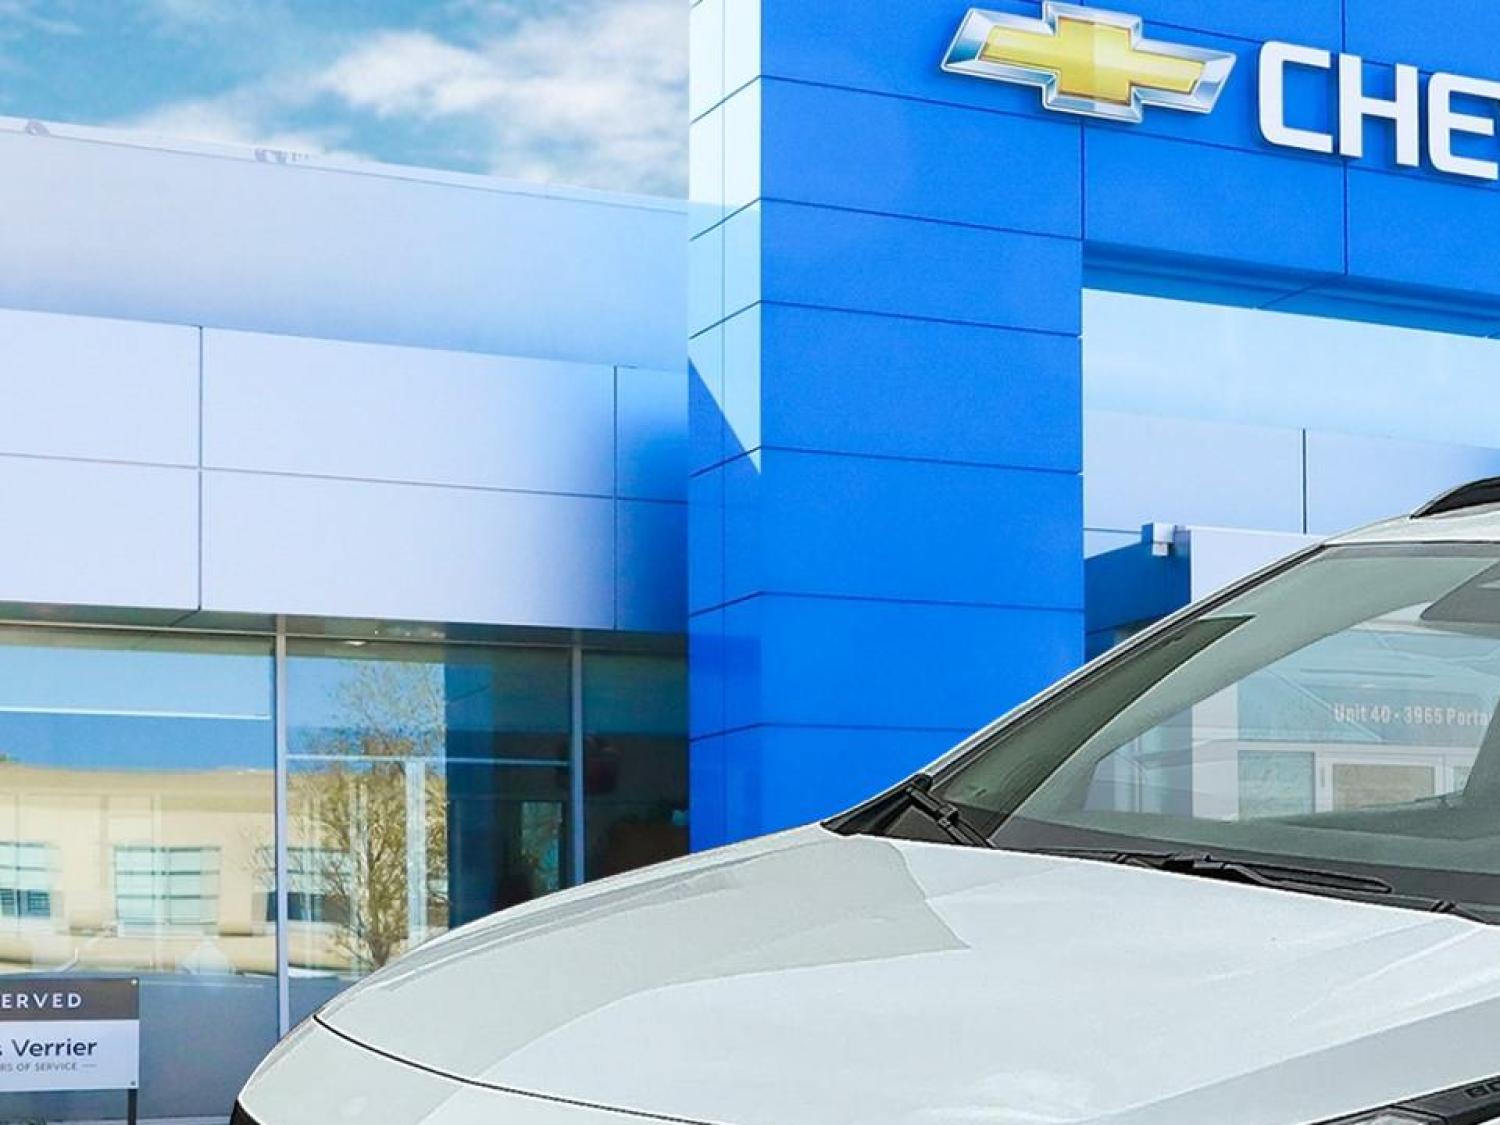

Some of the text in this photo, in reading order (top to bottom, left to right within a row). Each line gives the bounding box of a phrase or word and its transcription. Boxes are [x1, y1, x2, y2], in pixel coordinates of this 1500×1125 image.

[1335, 704, 1367, 722] Unit
[1370, 704, 1390, 723] 40
[1404, 706, 1442, 725] 3965
[11, 1037, 97, 1057] Verrier
[35, 1062, 77, 1072] SERVICE
